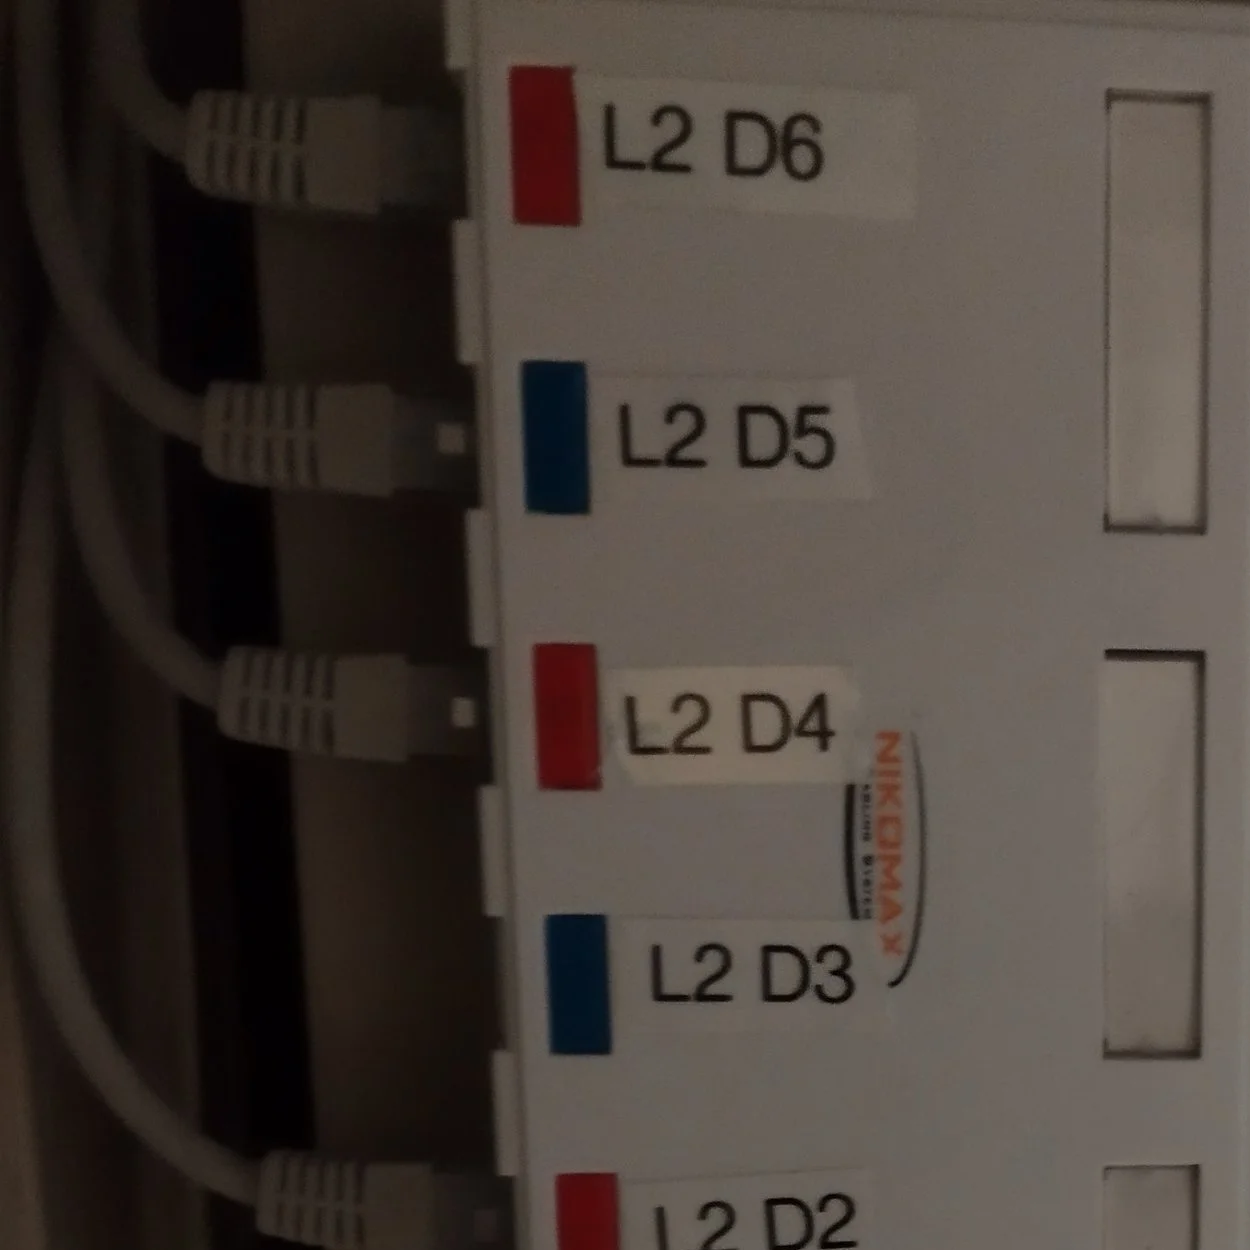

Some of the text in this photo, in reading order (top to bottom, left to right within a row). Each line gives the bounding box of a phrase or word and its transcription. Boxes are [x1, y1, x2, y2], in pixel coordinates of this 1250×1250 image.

[603, 104, 824, 182] L2 D6
[619, 402, 835, 470] L2 D5
[624, 692, 836, 756] L2 D4
[875, 729, 903, 957] NIKOMAX
[651, 943, 855, 1005] L2 D3
